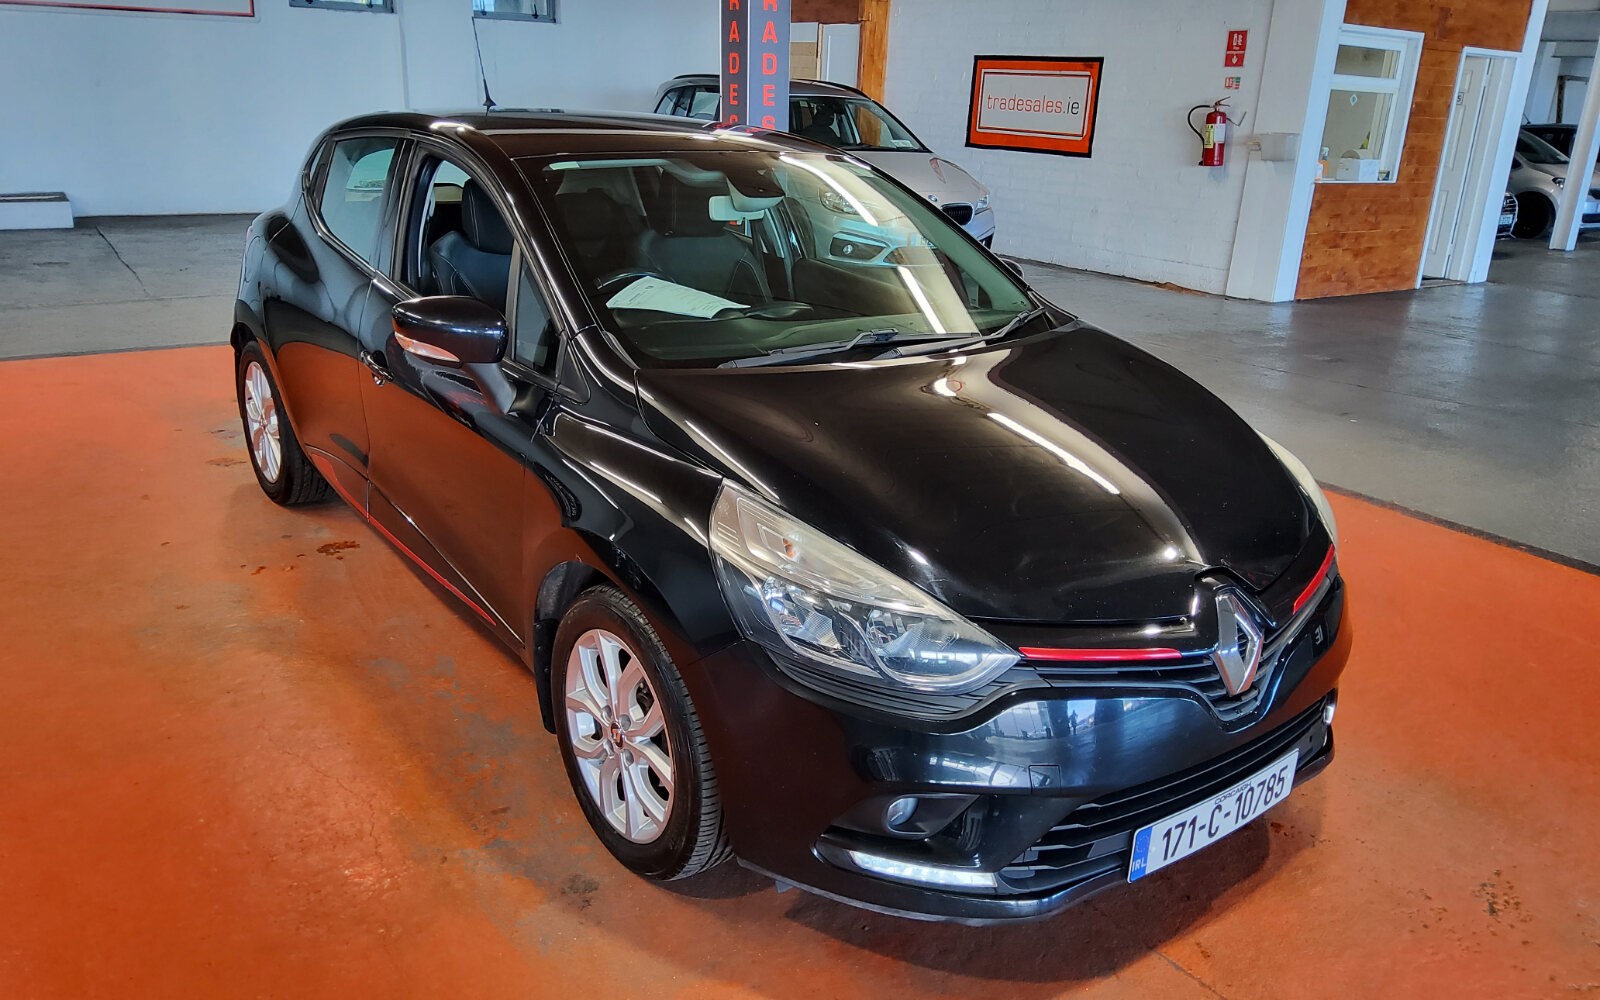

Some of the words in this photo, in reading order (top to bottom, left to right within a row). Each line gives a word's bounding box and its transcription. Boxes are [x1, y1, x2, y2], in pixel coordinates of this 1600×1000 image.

[987, 93, 1080, 115] tradesales.ie
[1162, 765, 1289, 862] 171-C-10785
[1131, 858, 1147, 873] IRL
